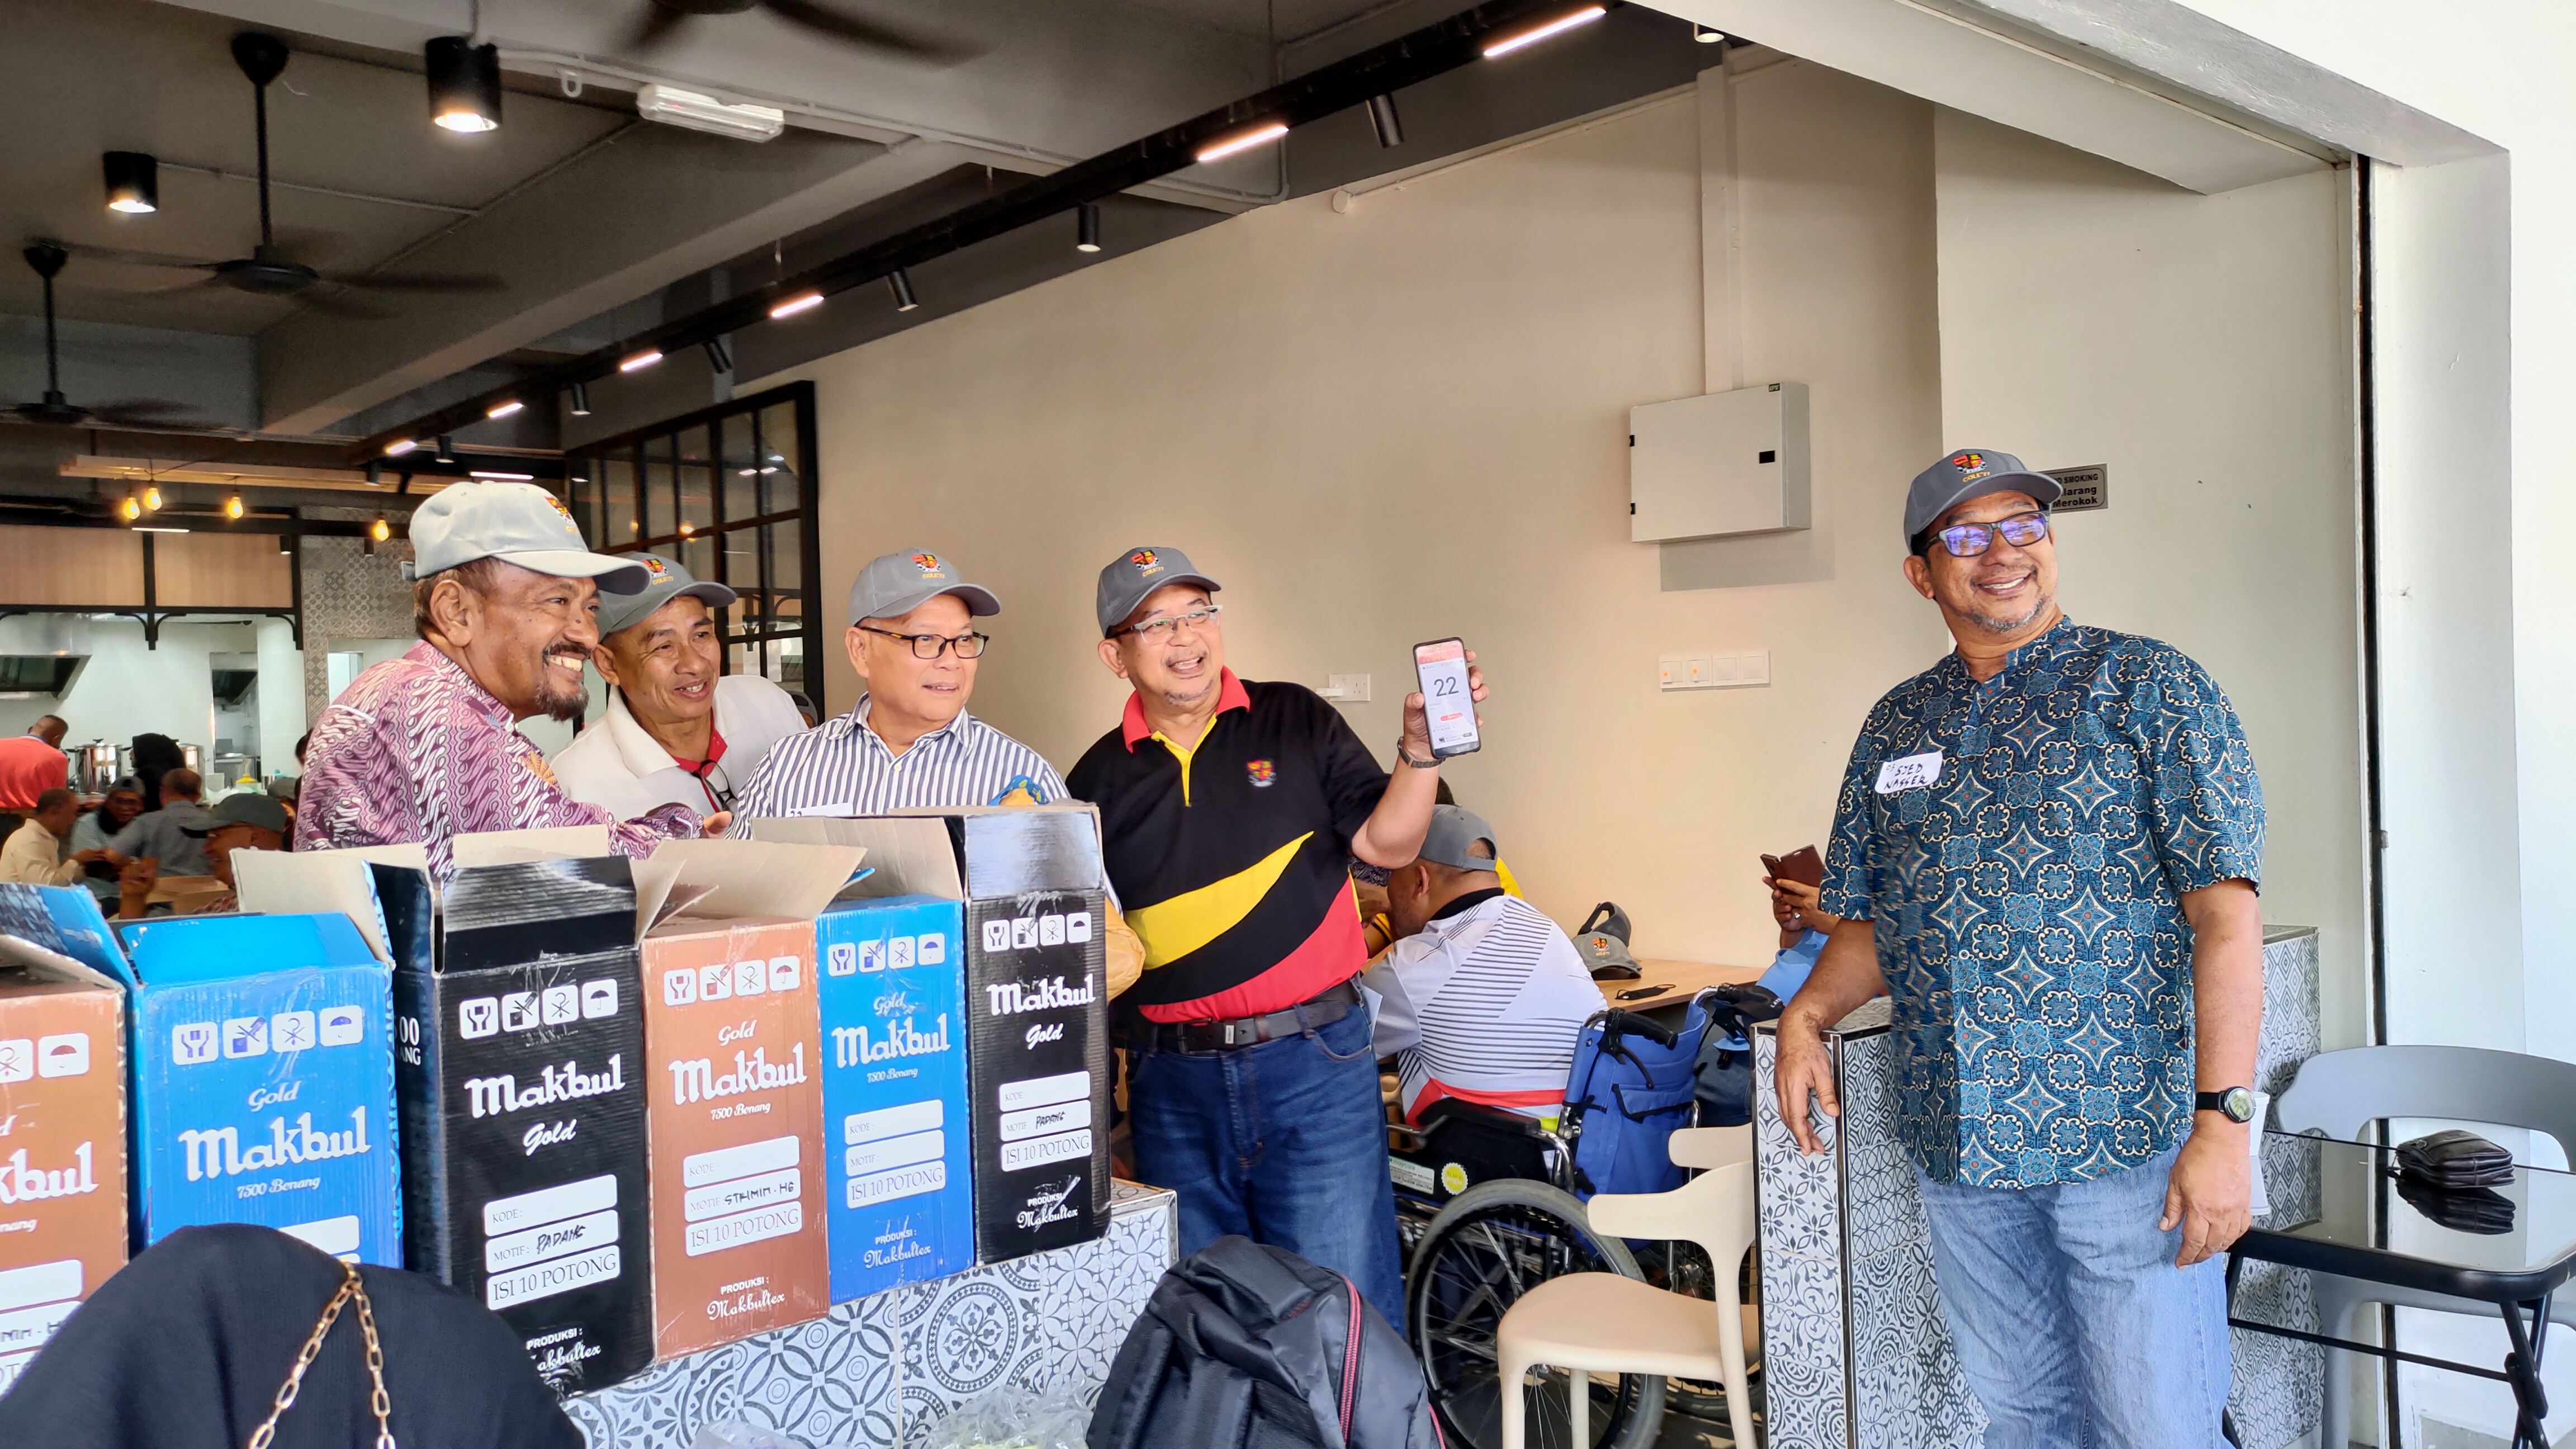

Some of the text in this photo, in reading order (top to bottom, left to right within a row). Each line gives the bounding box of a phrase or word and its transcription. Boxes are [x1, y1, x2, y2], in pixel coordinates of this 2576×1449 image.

[2061, 487, 2097, 496] larang
[2064, 473, 2099, 484] SMOKING
[2053, 496, 2098, 508] Merokok
[1433, 676, 1459, 697] 22
[873, 991, 907, 1016] Gold
[986, 973, 1096, 1016] Makbul
[718, 1019, 757, 1046] Gold
[831, 1012, 951, 1069] Makbul
[1025, 1023, 1064, 1050] Gold
[464, 1053, 626, 1119] Makbul
[668, 1041, 808, 1106] Makbul
[867, 1068, 918, 1083] 7500 Benang
[248, 1080, 302, 1112] Gold
[711, 1102, 771, 1121] 7500 Benang
[178, 1105, 372, 1182] Makbul
[523, 1119, 577, 1157] Gold
[1006, 1135, 1090, 1164] ISI 10 POTONG
[236, 1177, 321, 1199] 7500 Benang
[851, 1167, 943, 1201] ISI 10 POTONG
[691, 1209, 798, 1248] ISI 10 POTONG
[1016, 1204, 1079, 1229] Makbultex
[864, 1240, 932, 1270] Makbultex
[493, 1253, 617, 1301] ISI 10 POTONG
[707, 1289, 786, 1321] Makbultex
[531, 1339, 602, 1372] akbultex
